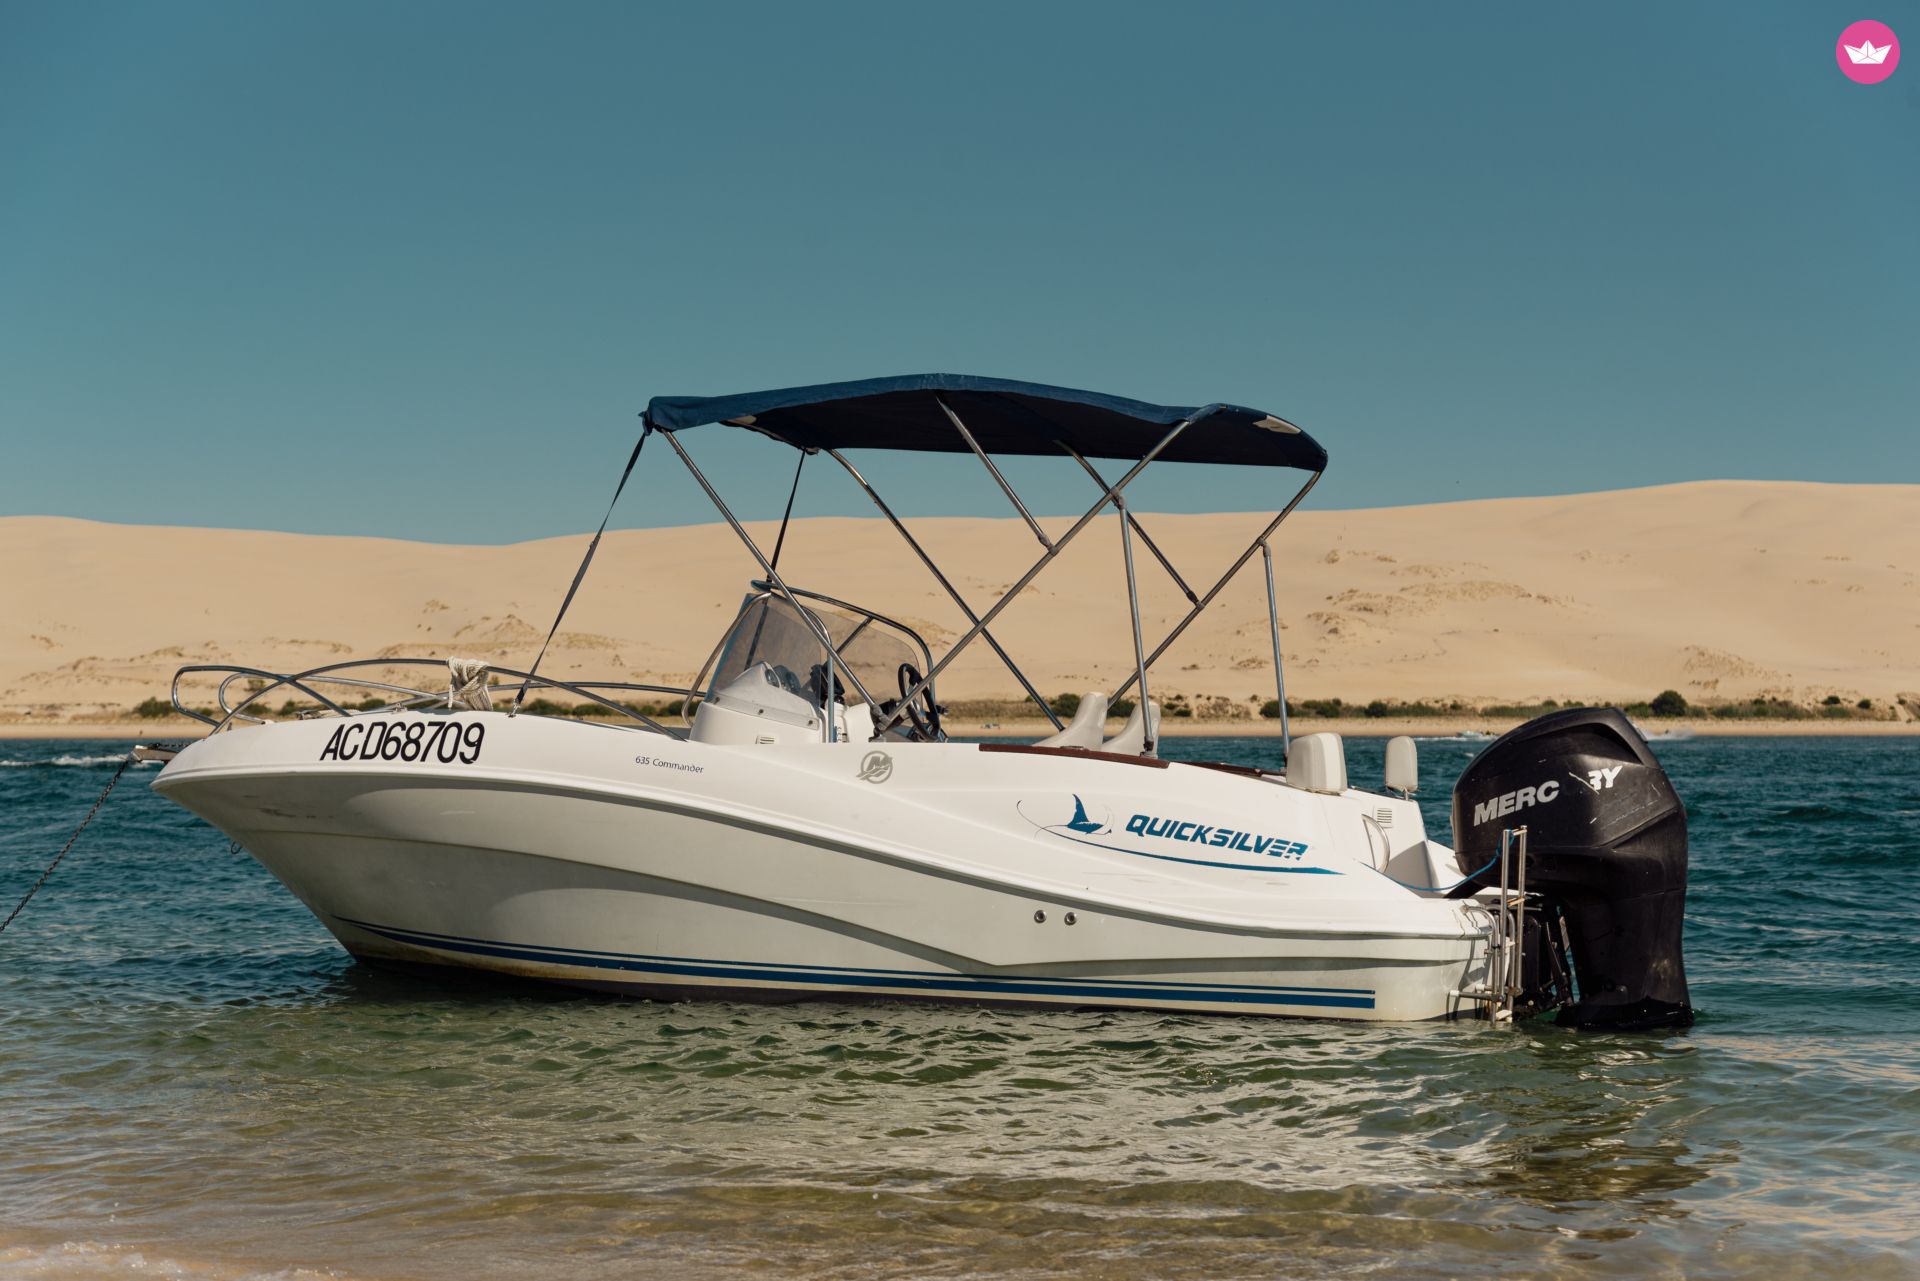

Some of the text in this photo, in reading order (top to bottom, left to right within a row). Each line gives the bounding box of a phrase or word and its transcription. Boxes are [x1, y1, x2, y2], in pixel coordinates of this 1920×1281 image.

[319, 721, 485, 765] ACD68709
[635, 756, 704, 773] 635 Commander
[1125, 814, 1309, 860] QUICKSILVER
